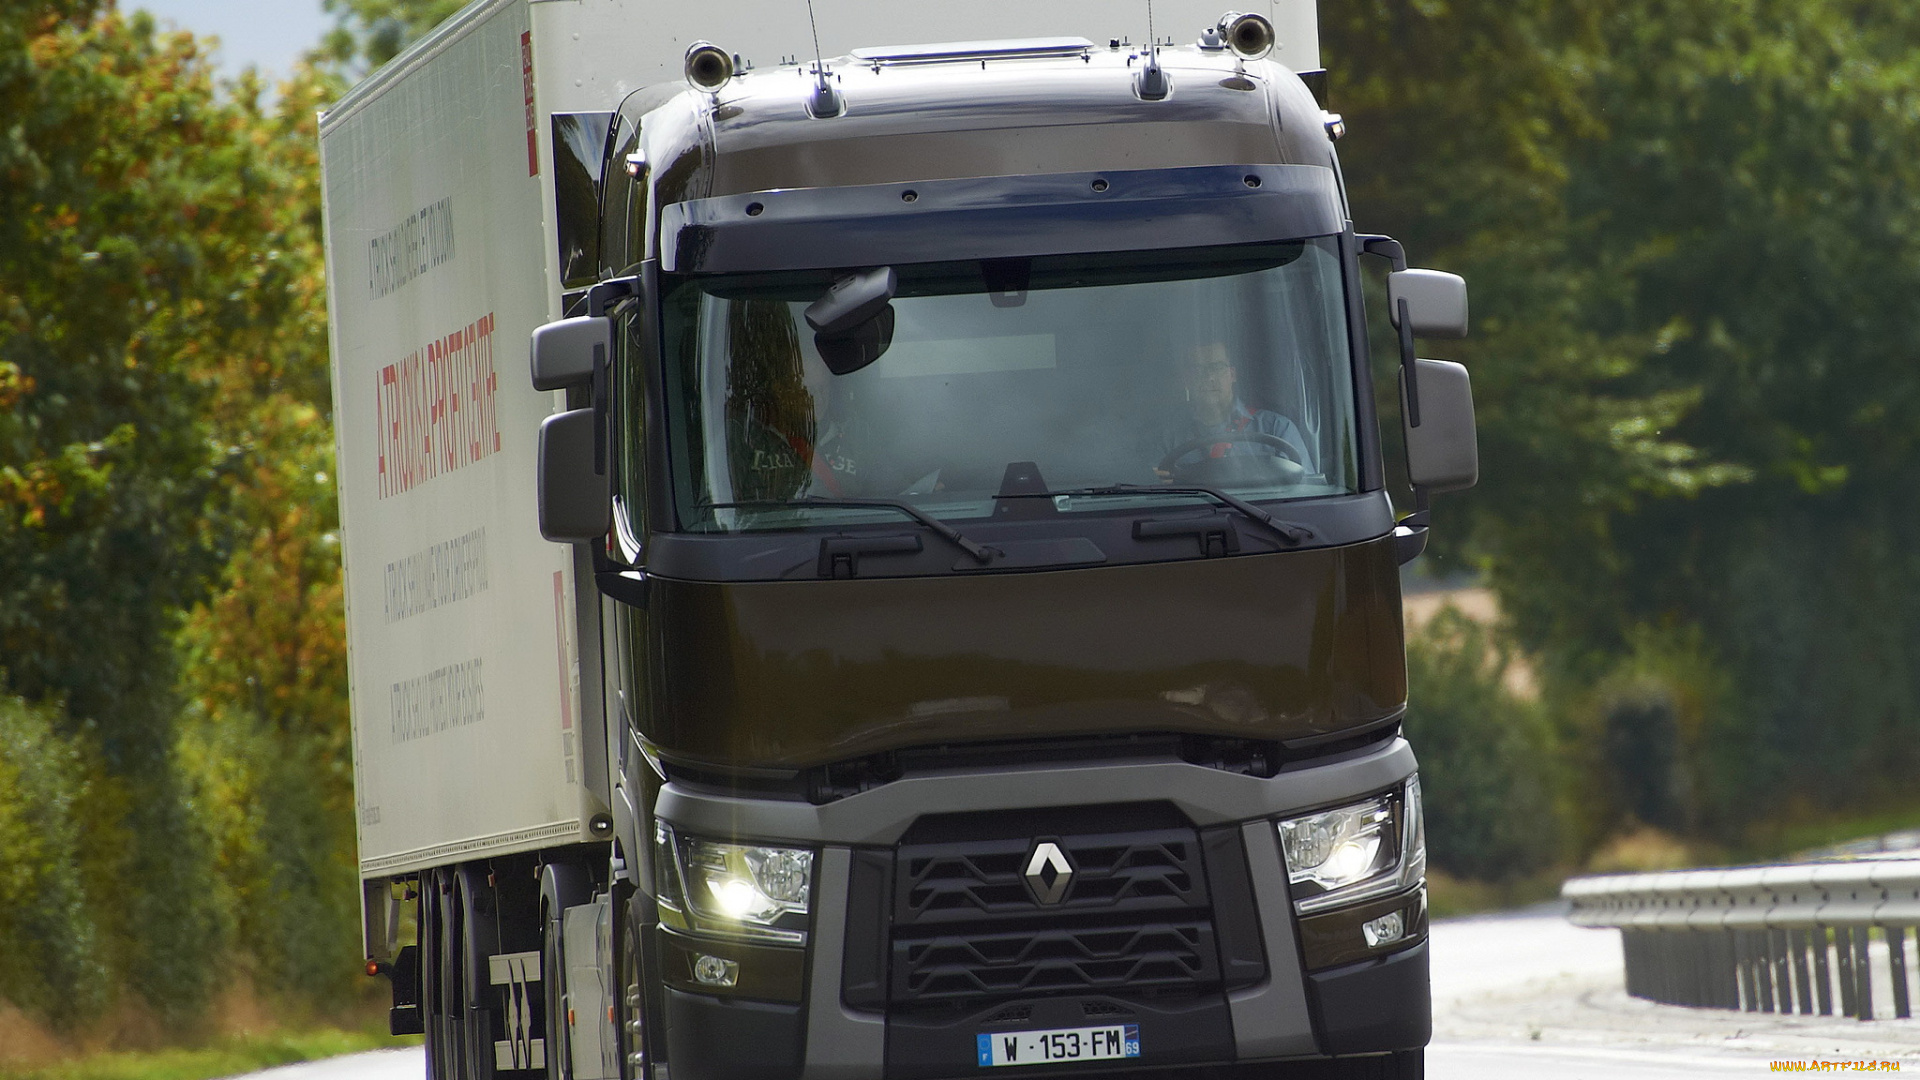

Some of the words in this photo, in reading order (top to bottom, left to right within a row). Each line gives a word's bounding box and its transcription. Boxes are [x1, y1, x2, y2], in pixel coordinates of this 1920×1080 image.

[376, 370, 387, 500] A
[382, 352, 418, 499] TRUCK
[427, 329, 467, 478] PROFIT
[464, 311, 501, 464] CENTRE
[1125, 1041, 1140, 1055] 69
